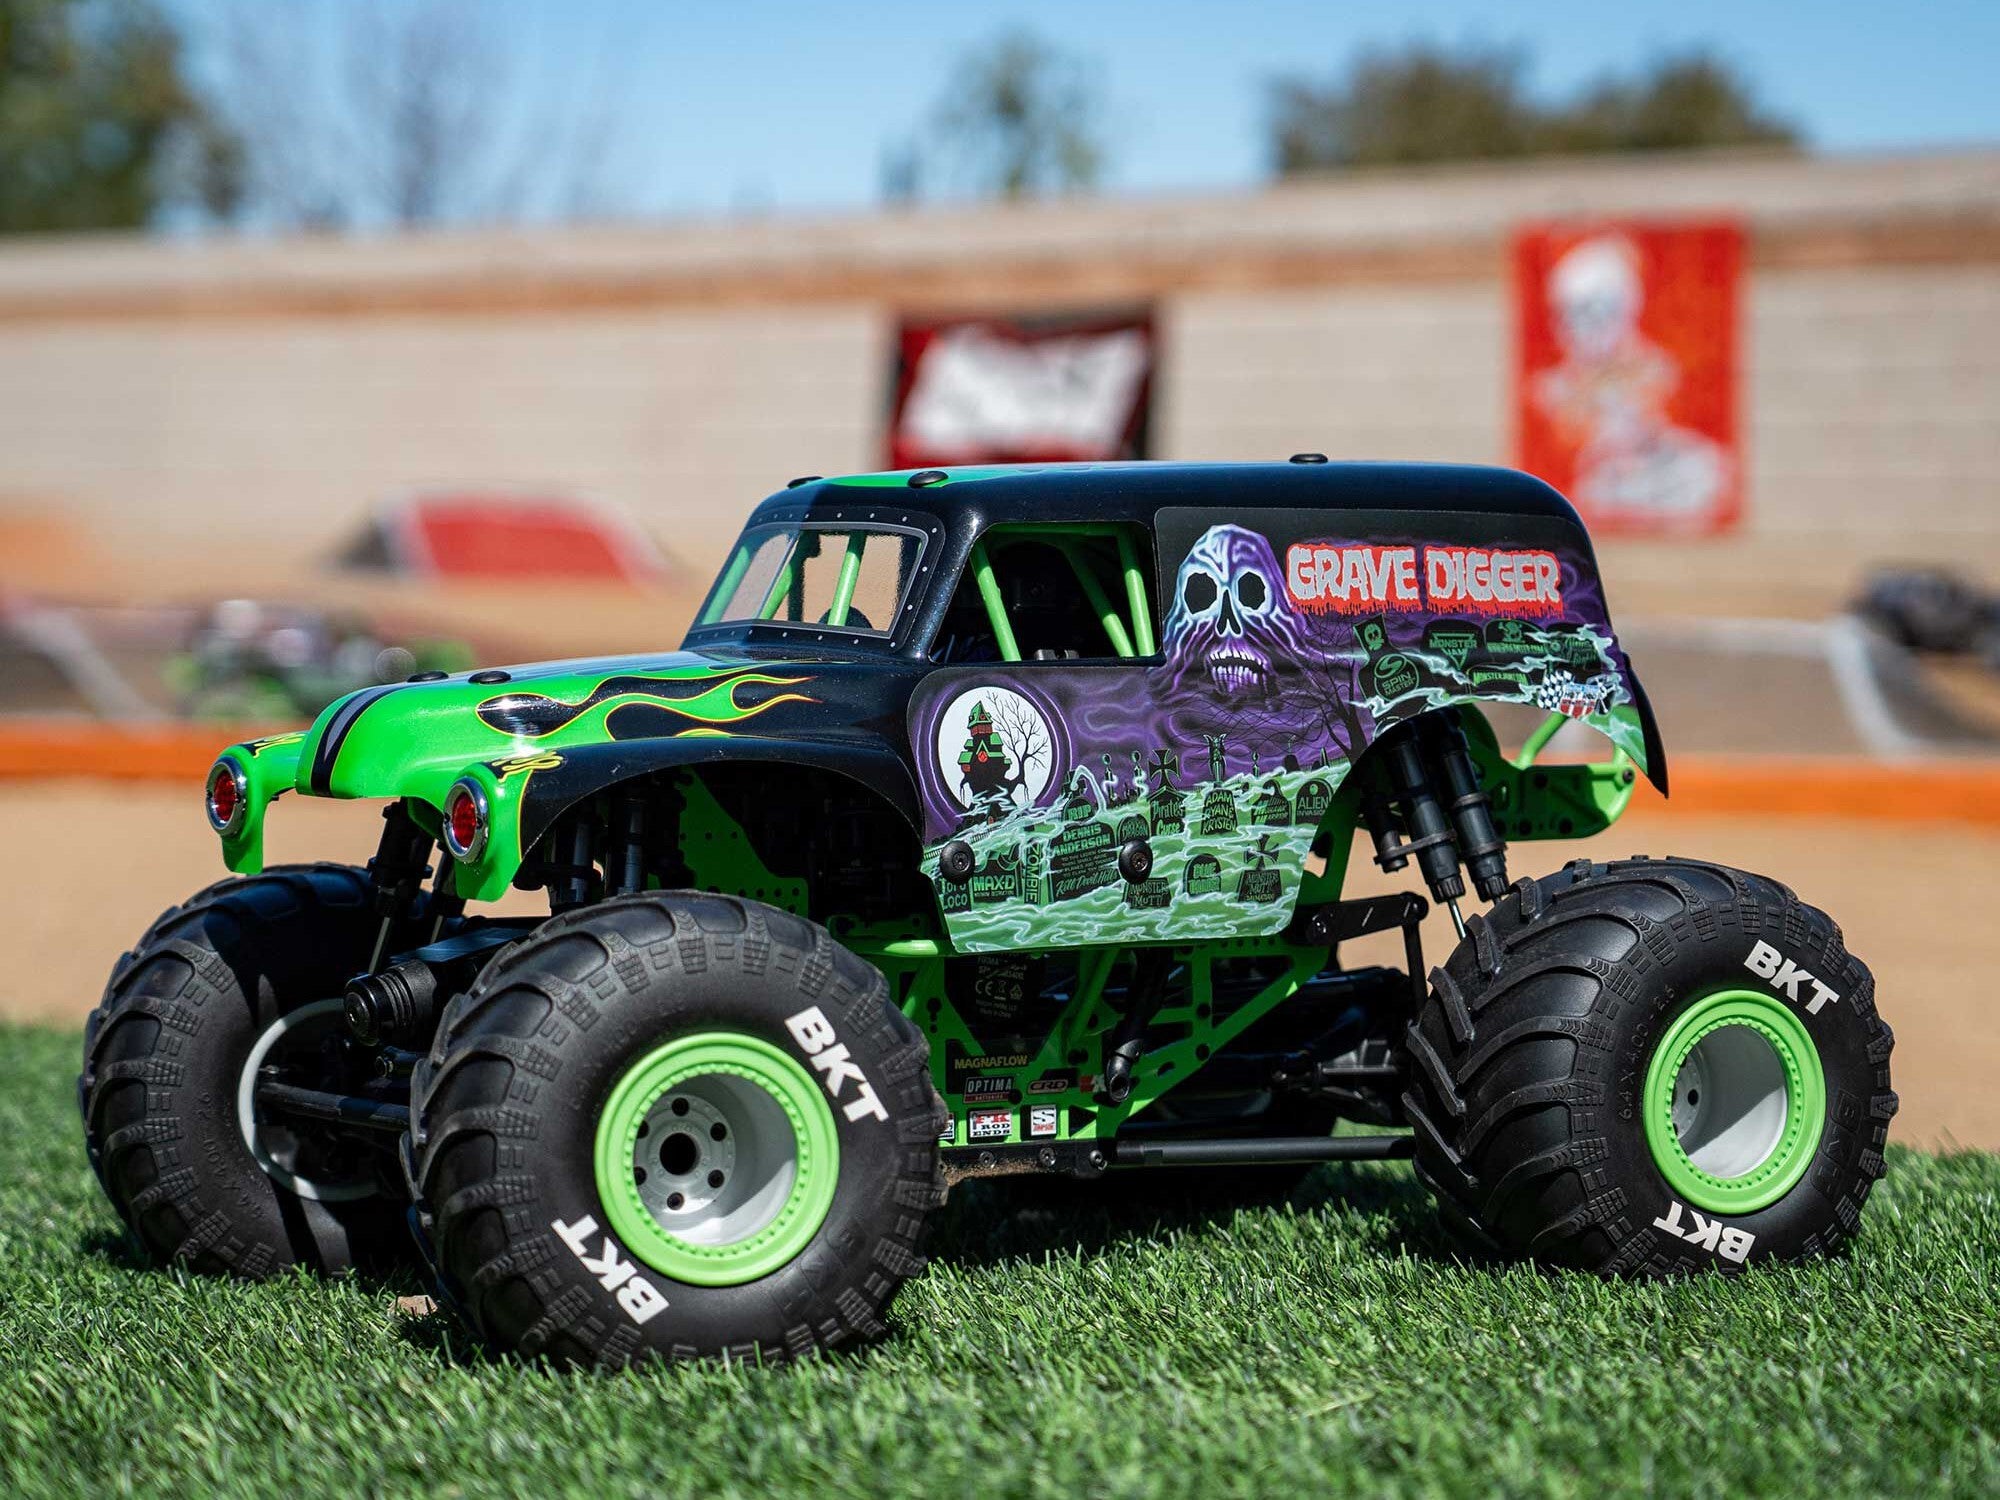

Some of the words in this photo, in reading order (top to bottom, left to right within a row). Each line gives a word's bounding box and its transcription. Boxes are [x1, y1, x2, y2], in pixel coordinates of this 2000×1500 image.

[1287, 546, 1420, 611] GRAVE
[1424, 547, 1563, 614] DIGGER
[1429, 639, 1477, 648] MONSTER
[1382, 672, 1412, 690] SPIN
[1384, 679, 1416, 695] MASTER
[1206, 791, 1233, 807] ADAM
[1297, 796, 1329, 810] ALIEN
[1067, 804, 1092, 820] RIP
[1062, 824, 1101, 842] DENNIS
[1156, 819, 1180, 836] Curse
[1053, 834, 1111, 857] ANDERSON
[1025, 843, 1041, 903] ZOMBIE
[943, 893, 968, 910] LOCO
[1744, 939, 1840, 1015] BKT
[784, 1006, 889, 1123] BKT
[955, 1055, 1028, 1069] MAGNAFLOW
[967, 1078, 1013, 1093] OPTIMA
[977, 1112, 1010, 1124] FK
[981, 1123, 1010, 1131] ROD
[1653, 1200, 1756, 1264] BKT
[551, 1213, 669, 1325] BKT
